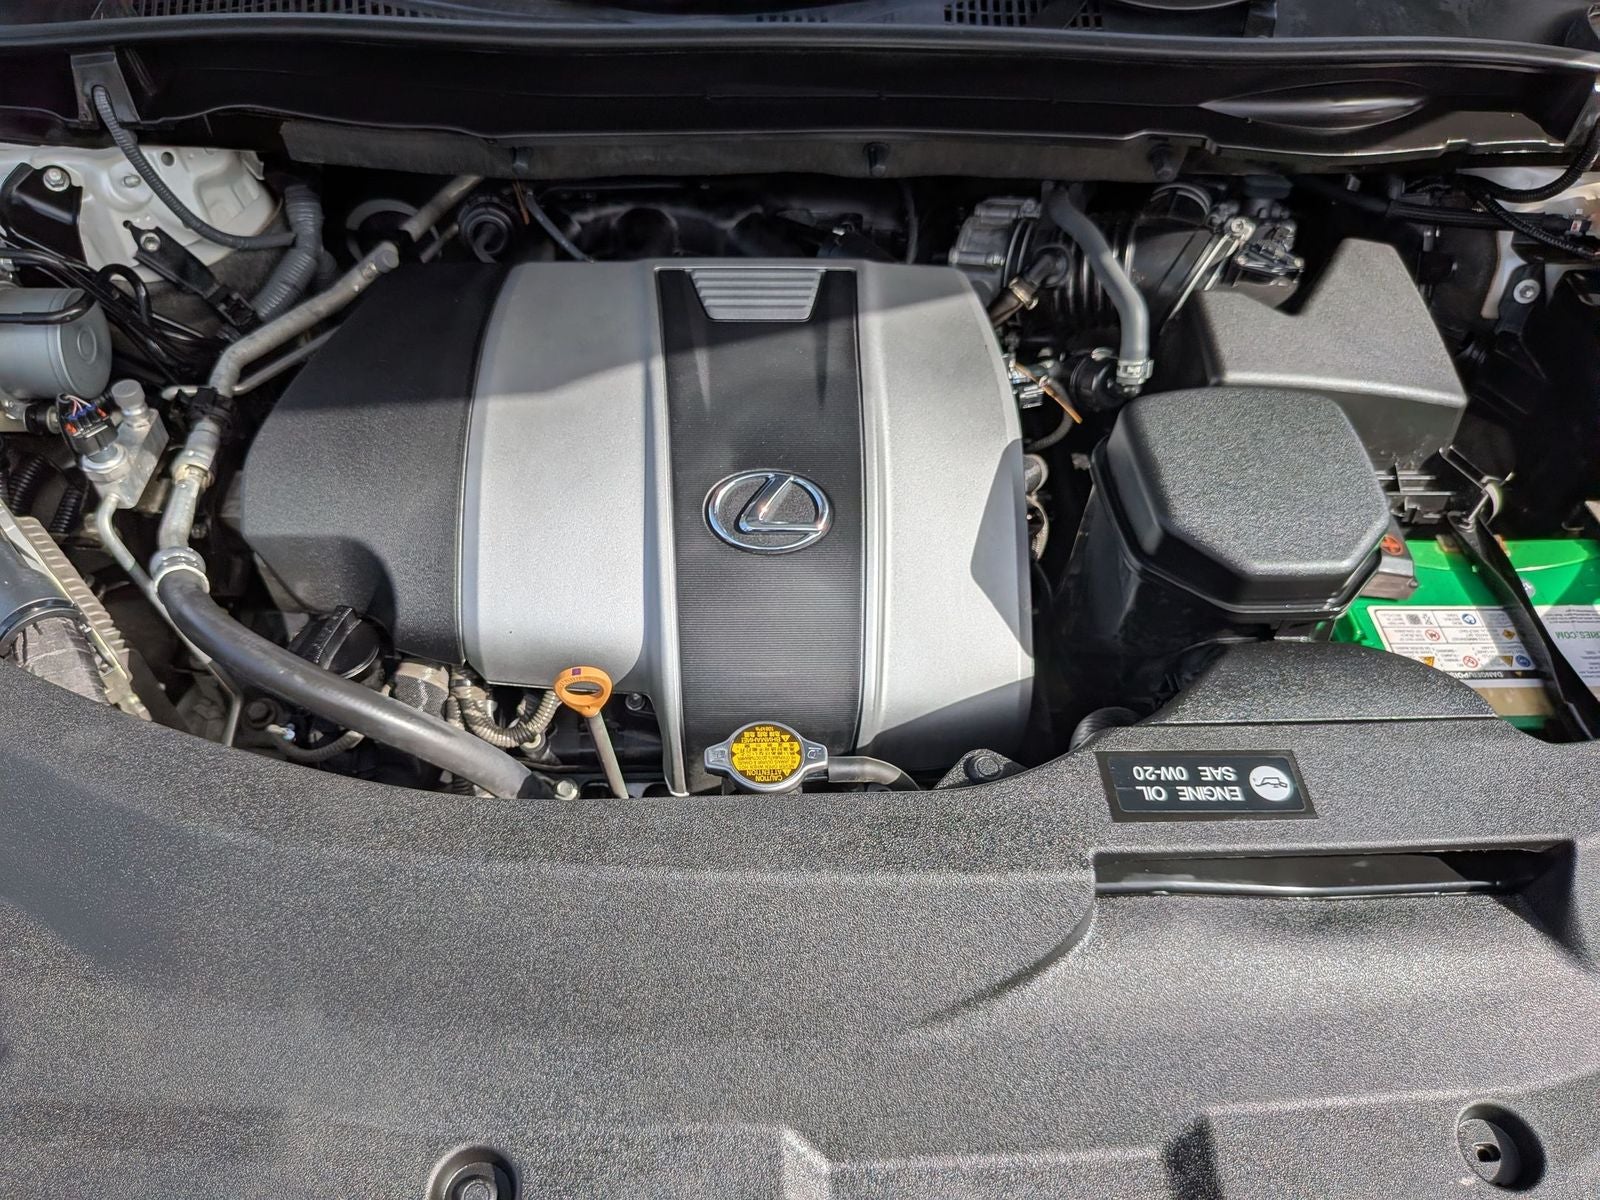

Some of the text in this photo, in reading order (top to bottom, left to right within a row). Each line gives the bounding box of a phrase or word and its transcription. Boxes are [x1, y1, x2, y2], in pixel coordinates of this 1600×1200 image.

[1132, 766, 1238, 782] SAE 0W-20
[1135, 786, 1246, 801] ENGINE OIL
